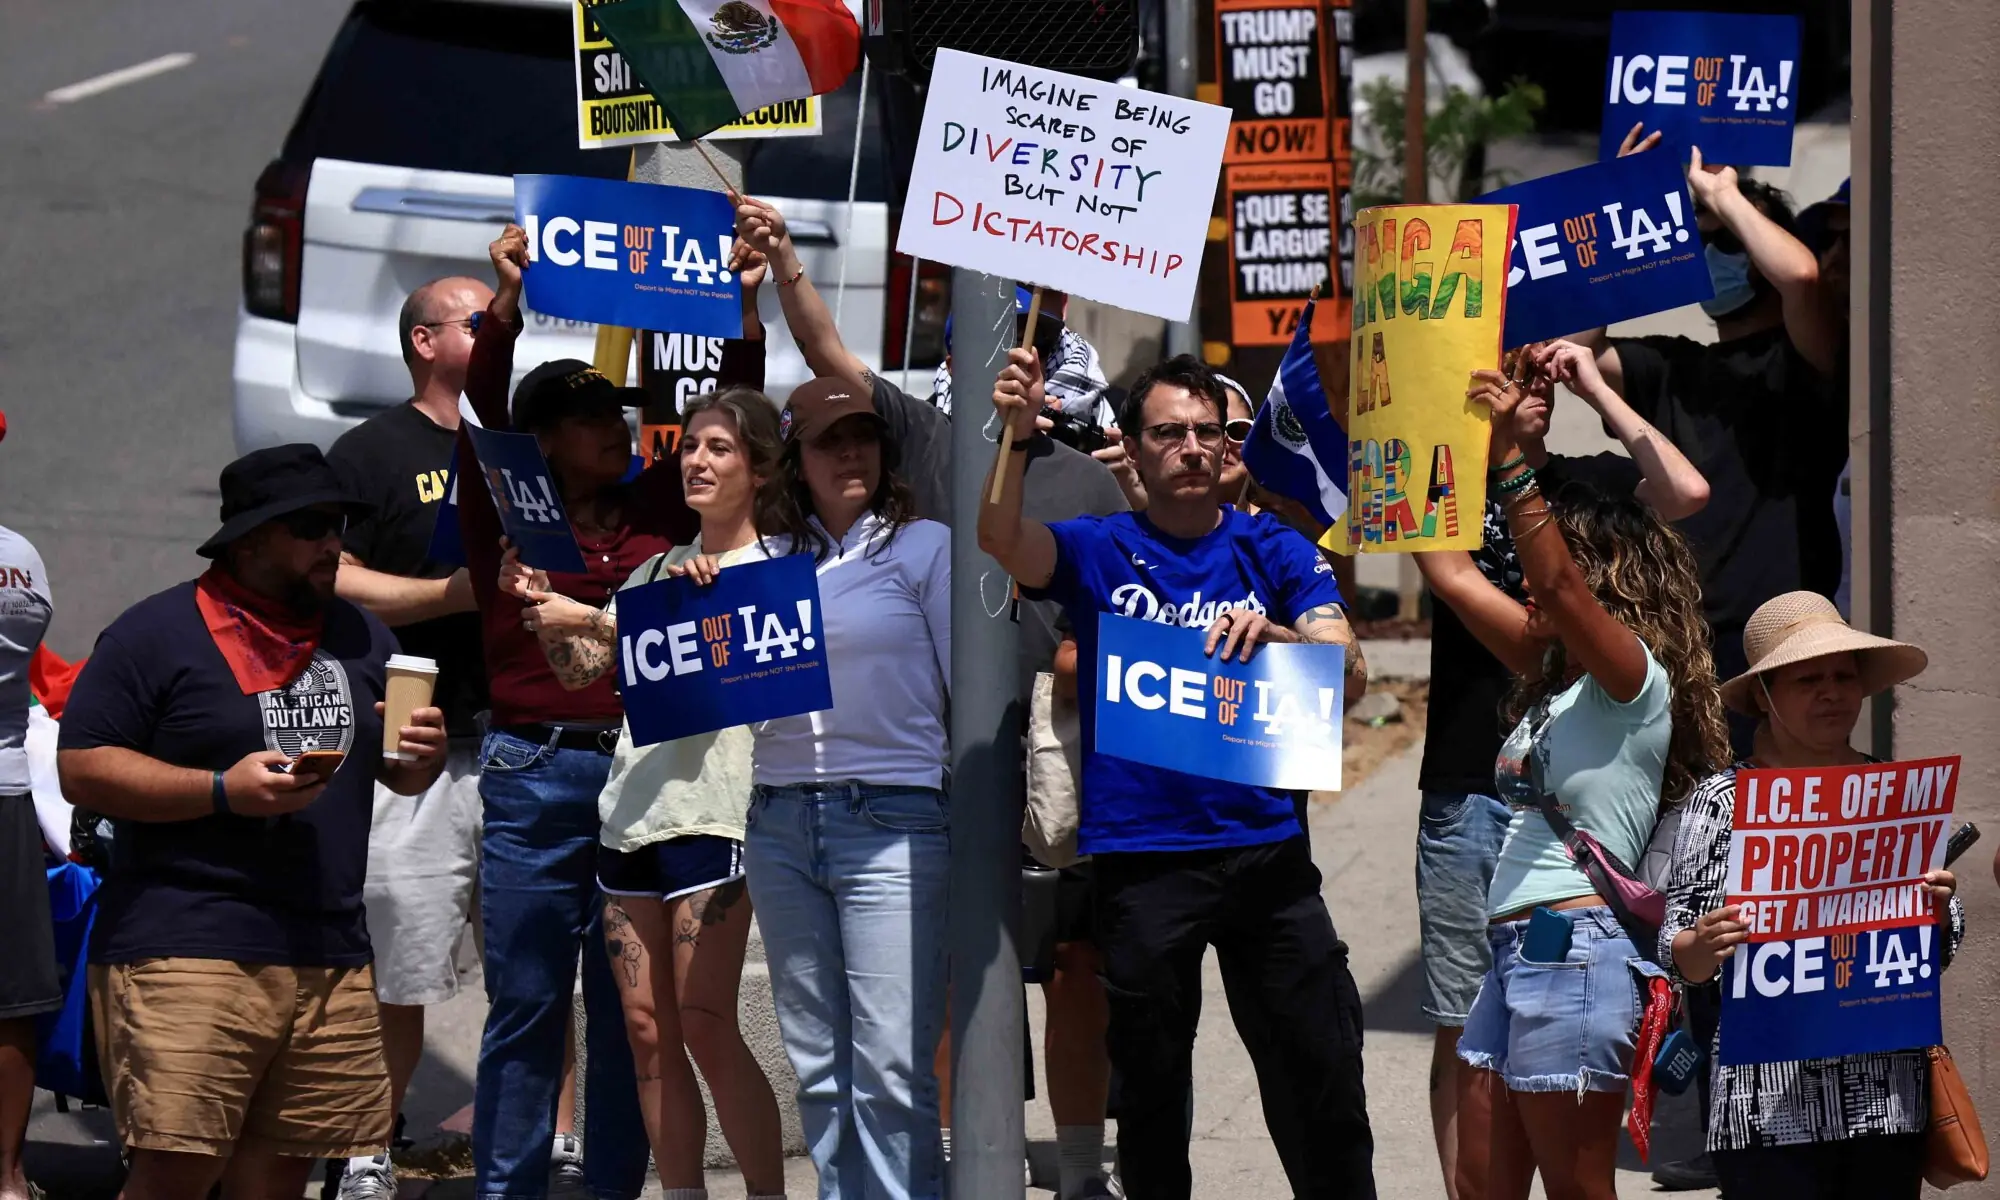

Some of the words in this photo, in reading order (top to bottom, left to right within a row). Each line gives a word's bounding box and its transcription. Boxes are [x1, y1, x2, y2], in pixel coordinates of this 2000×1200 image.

[1221, 9, 1316, 45] TRUMP
[1232, 46, 1310, 81] MUST
[1609, 54, 1689, 105] ICE
[1693, 57, 1724, 81] OUT
[982, 66, 1098, 111] IMAGINE
[1114, 99, 1191, 134] BEING
[1254, 81, 1294, 116] GO
[1696, 82, 1717, 107] OF
[1727, 54, 1793, 112] LA!
[1006, 106, 1096, 143] SCARED
[1111, 137, 1147, 157] OF
[1234, 124, 1316, 154] NOW!
[942, 122, 1162, 202] DIVERSITY
[1005, 174, 1064, 206] BUT
[1076, 195, 1138, 224] NOT
[1235, 195, 1297, 229] ¡QUE
[1302, 193, 1330, 223] SE
[525, 214, 618, 271] ICE
[623, 225, 655, 250] OUT
[932, 191, 1183, 279] DICTATORSHIP
[1563, 212, 1598, 244] OUT
[1602, 190, 1689, 260] LA!
[662, 225, 733, 285] LA!
[1235, 229, 1331, 260] LARGUE
[1576, 241, 1598, 269] OF
[1642, 262, 1657, 271] NOT
[1658, 259, 1671, 267] the
[1671, 252, 1695, 263] People
[629, 250, 649, 275] OF
[1240, 262, 1328, 294] TRUMP
[684, 288, 698, 296] NOT
[711, 291, 733, 299] People
[653, 332, 725, 372] MUS
[1357, 331, 1391, 416] LA
[500, 467, 561, 523] LA!
[702, 613, 732, 643] OUT
[738, 599, 816, 664] LA!
[622, 620, 703, 687] ICE
[711, 641, 731, 668] OF
[769, 666, 783, 675] NOT
[785, 664, 796, 672] the
[796, 660, 819, 670] People
[271, 693, 341, 709] ARICAN
[1106, 654, 1207, 720] ICE
[1213, 675, 1246, 703] OUT
[265, 706, 351, 728] OUTLAWS
[1218, 701, 1240, 726] OF
[1746, 776, 1829, 824] I.C.E.
[1840, 770, 1896, 820] OFF
[1901, 764, 1953, 814] MY
[1740, 819, 1945, 892] PROPERTY
[1739, 900, 1788, 934] GET
[1793, 898, 1809, 932] A
[1817, 884, 1934, 929] WARRANT!
[1830, 932, 1858, 961] OUT
[1865, 924, 1933, 988] LA!
[1732, 936, 1825, 999] ICE
[1834, 961, 1853, 990] OF
[1667, 1047, 1699, 1081] JBL
